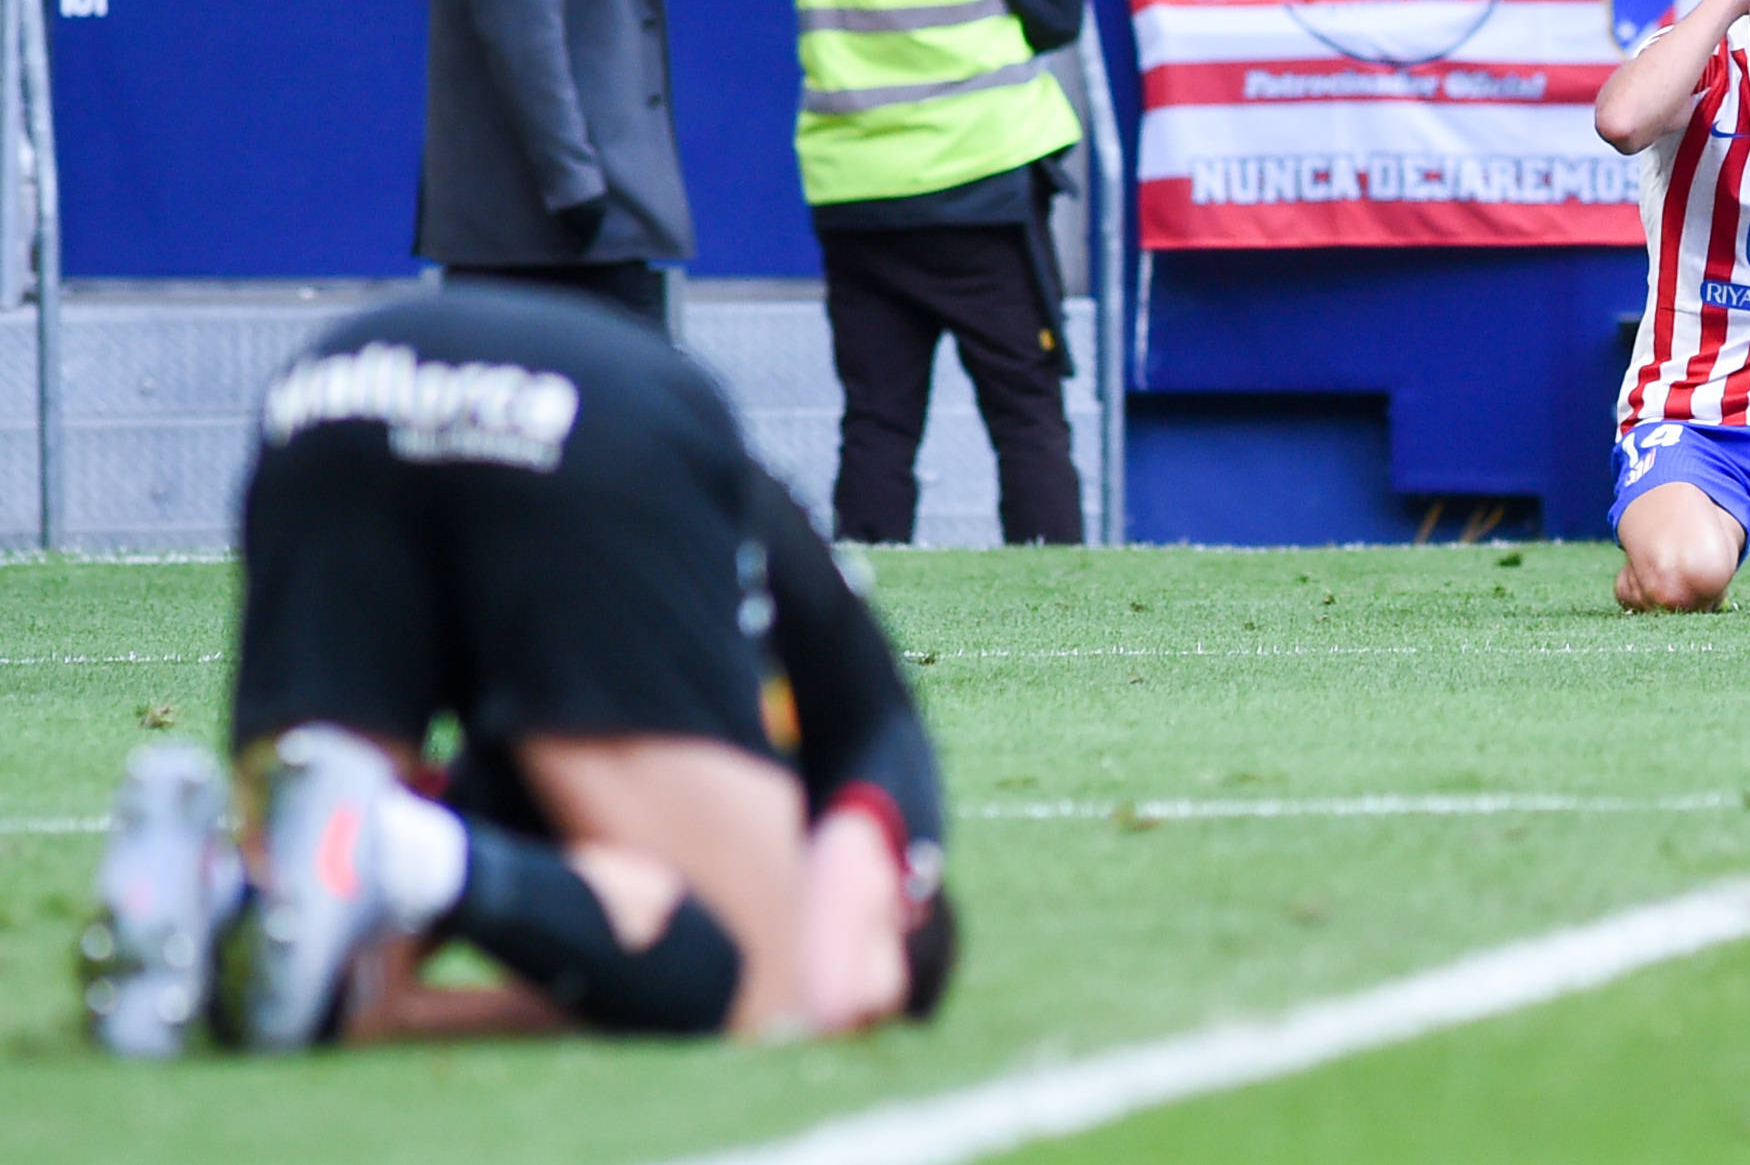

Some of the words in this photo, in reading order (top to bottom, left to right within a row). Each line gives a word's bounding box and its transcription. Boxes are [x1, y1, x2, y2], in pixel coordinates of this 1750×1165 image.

[1190, 154, 1362, 204] NUNCA
[1367, 152, 1641, 204] DEJAREMOS
[1622, 424, 1684, 468] 14
